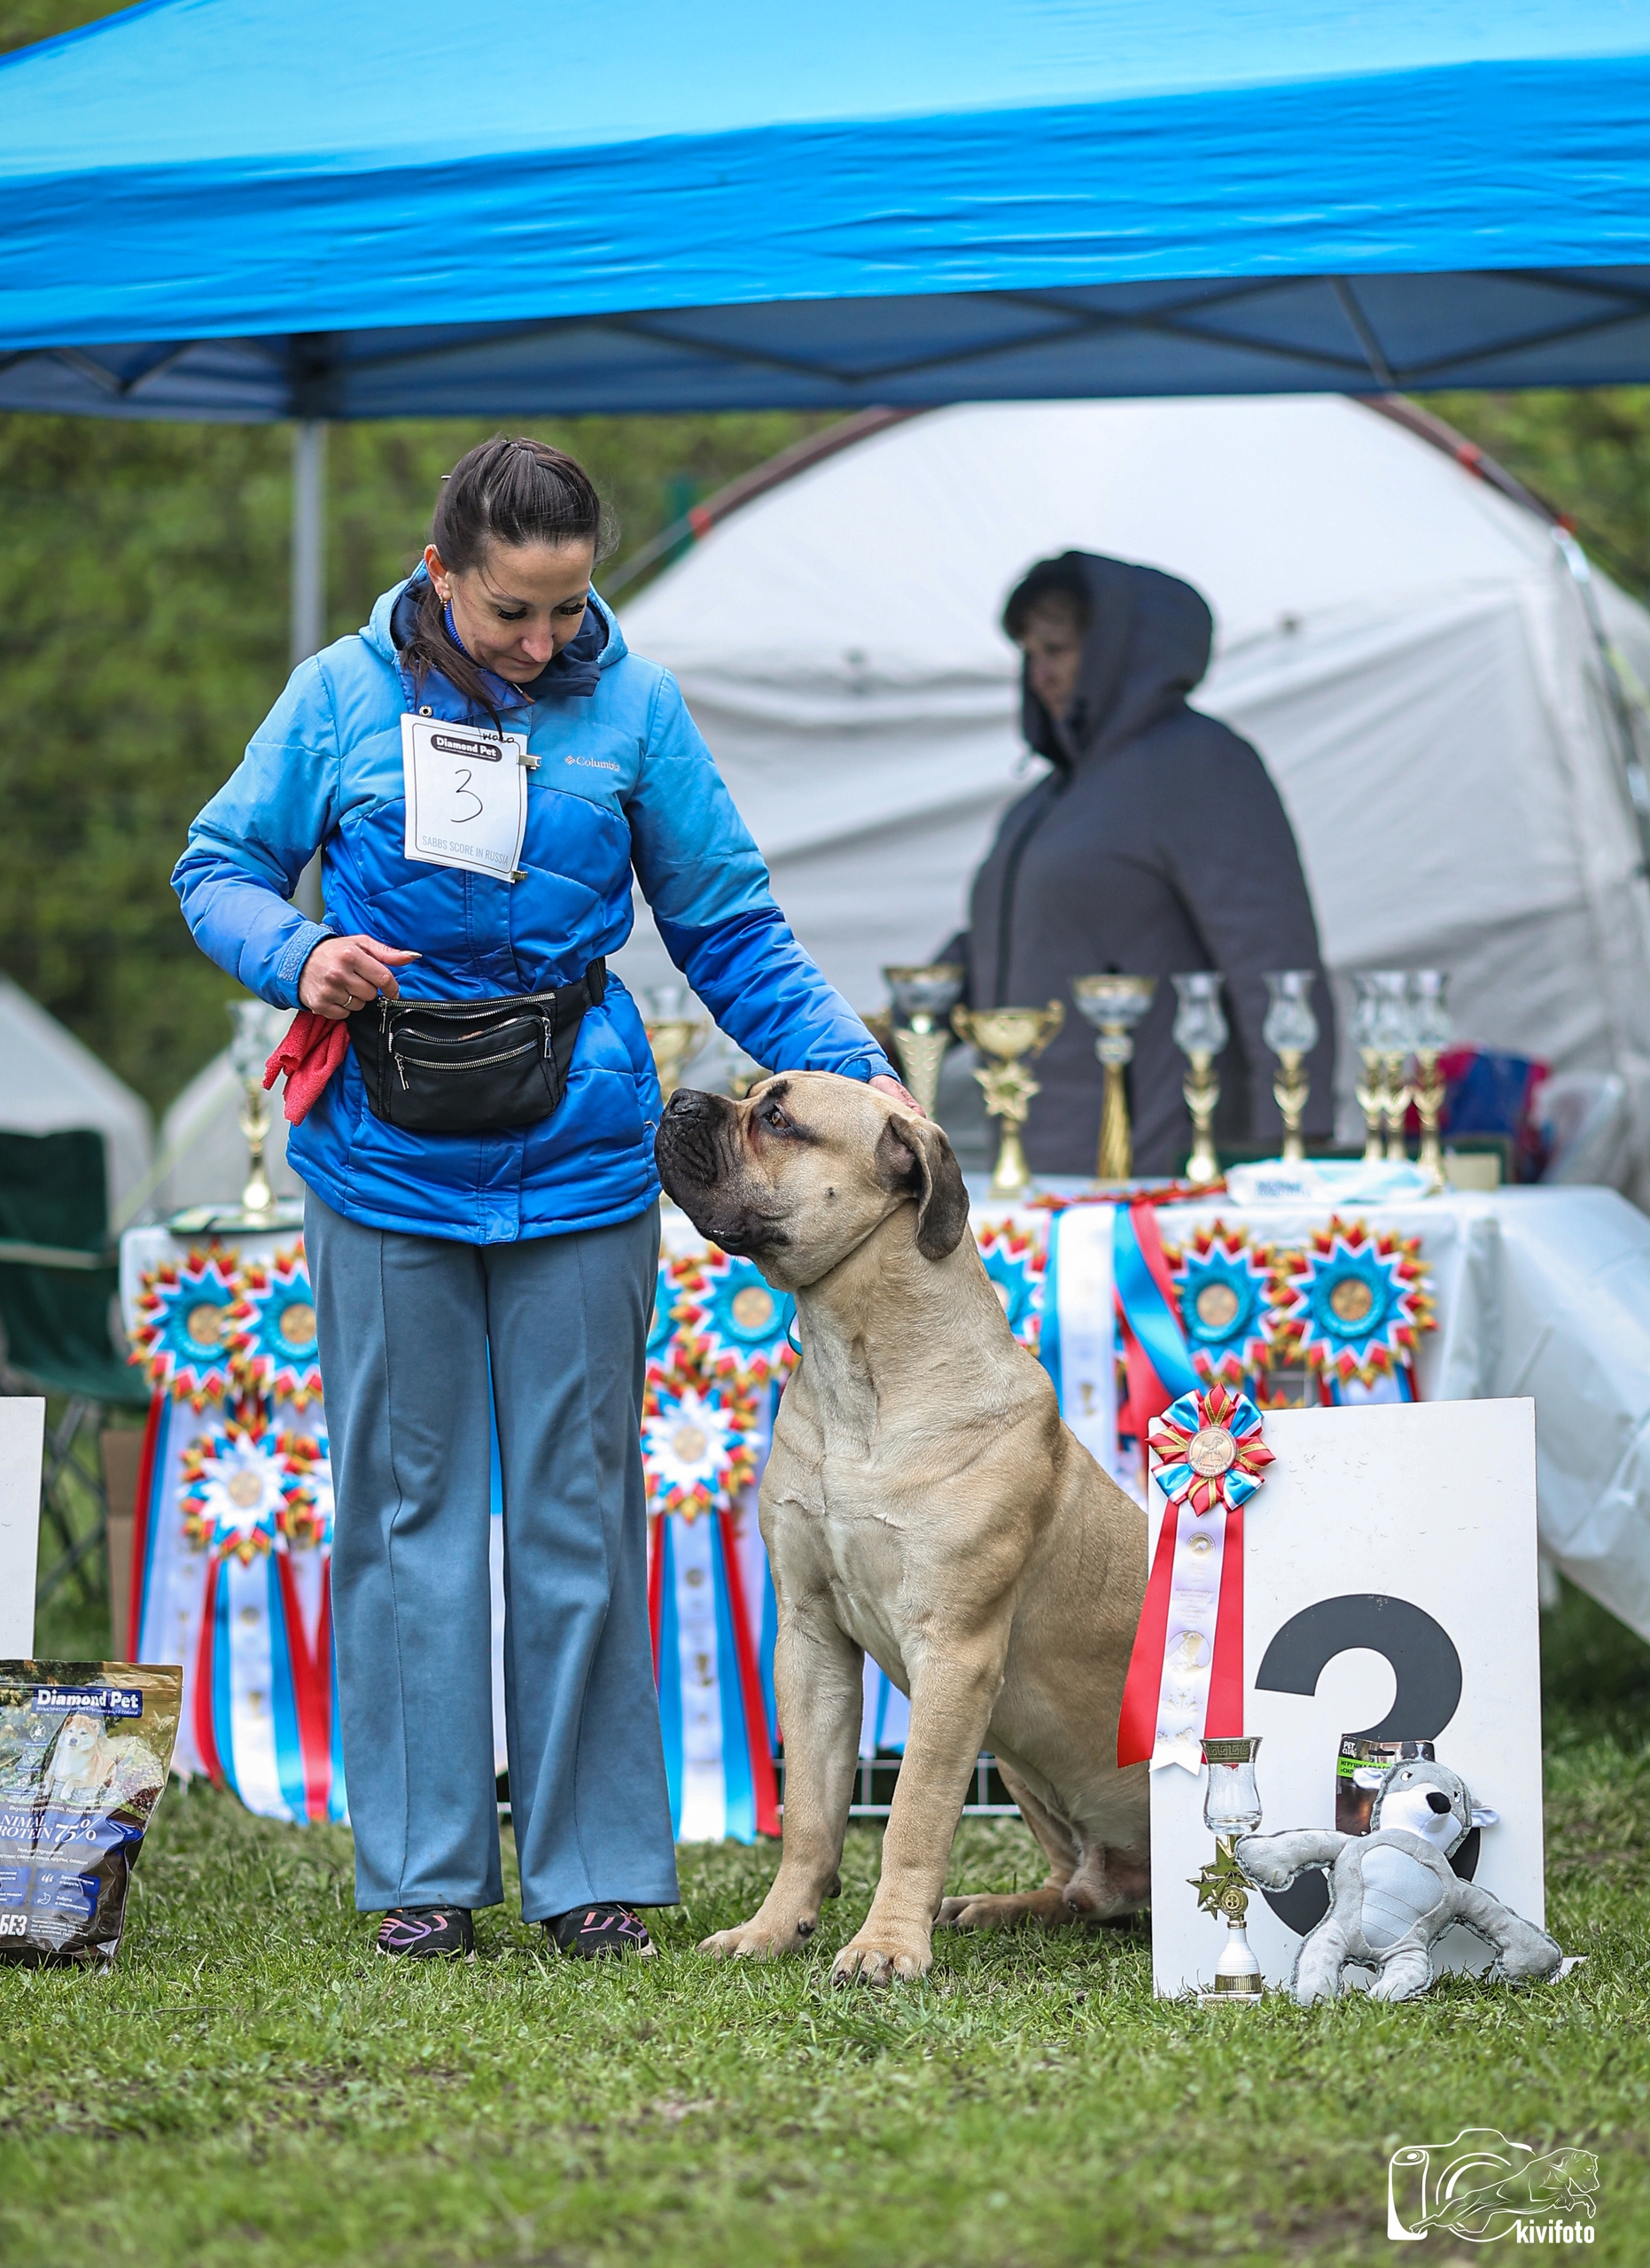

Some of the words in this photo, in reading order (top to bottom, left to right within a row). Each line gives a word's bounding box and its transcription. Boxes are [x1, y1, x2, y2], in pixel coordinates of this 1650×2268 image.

[436, 736, 479, 753] Diamond
[479, 745, 497, 757] Pet
[576, 757, 620, 772] Columbia
[450, 768, 483, 823] 3
[422, 835, 448, 850] SABBS
[449, 840, 474, 857] SCORE
[476, 847, 485, 858] IN
[485, 849, 509, 866] RUSSIA
[37, 1689, 107, 1706] Diamond
[110, 1691, 139, 1709] Pet
[1255, 1593, 1482, 1938] 3
[0, 1825, 53, 1839] ROTEIN
[54, 1818, 101, 1843] 75%
[1, 1814, 47, 1827] NIMAL
[0, 1914, 27, 1937] БЕЗ
